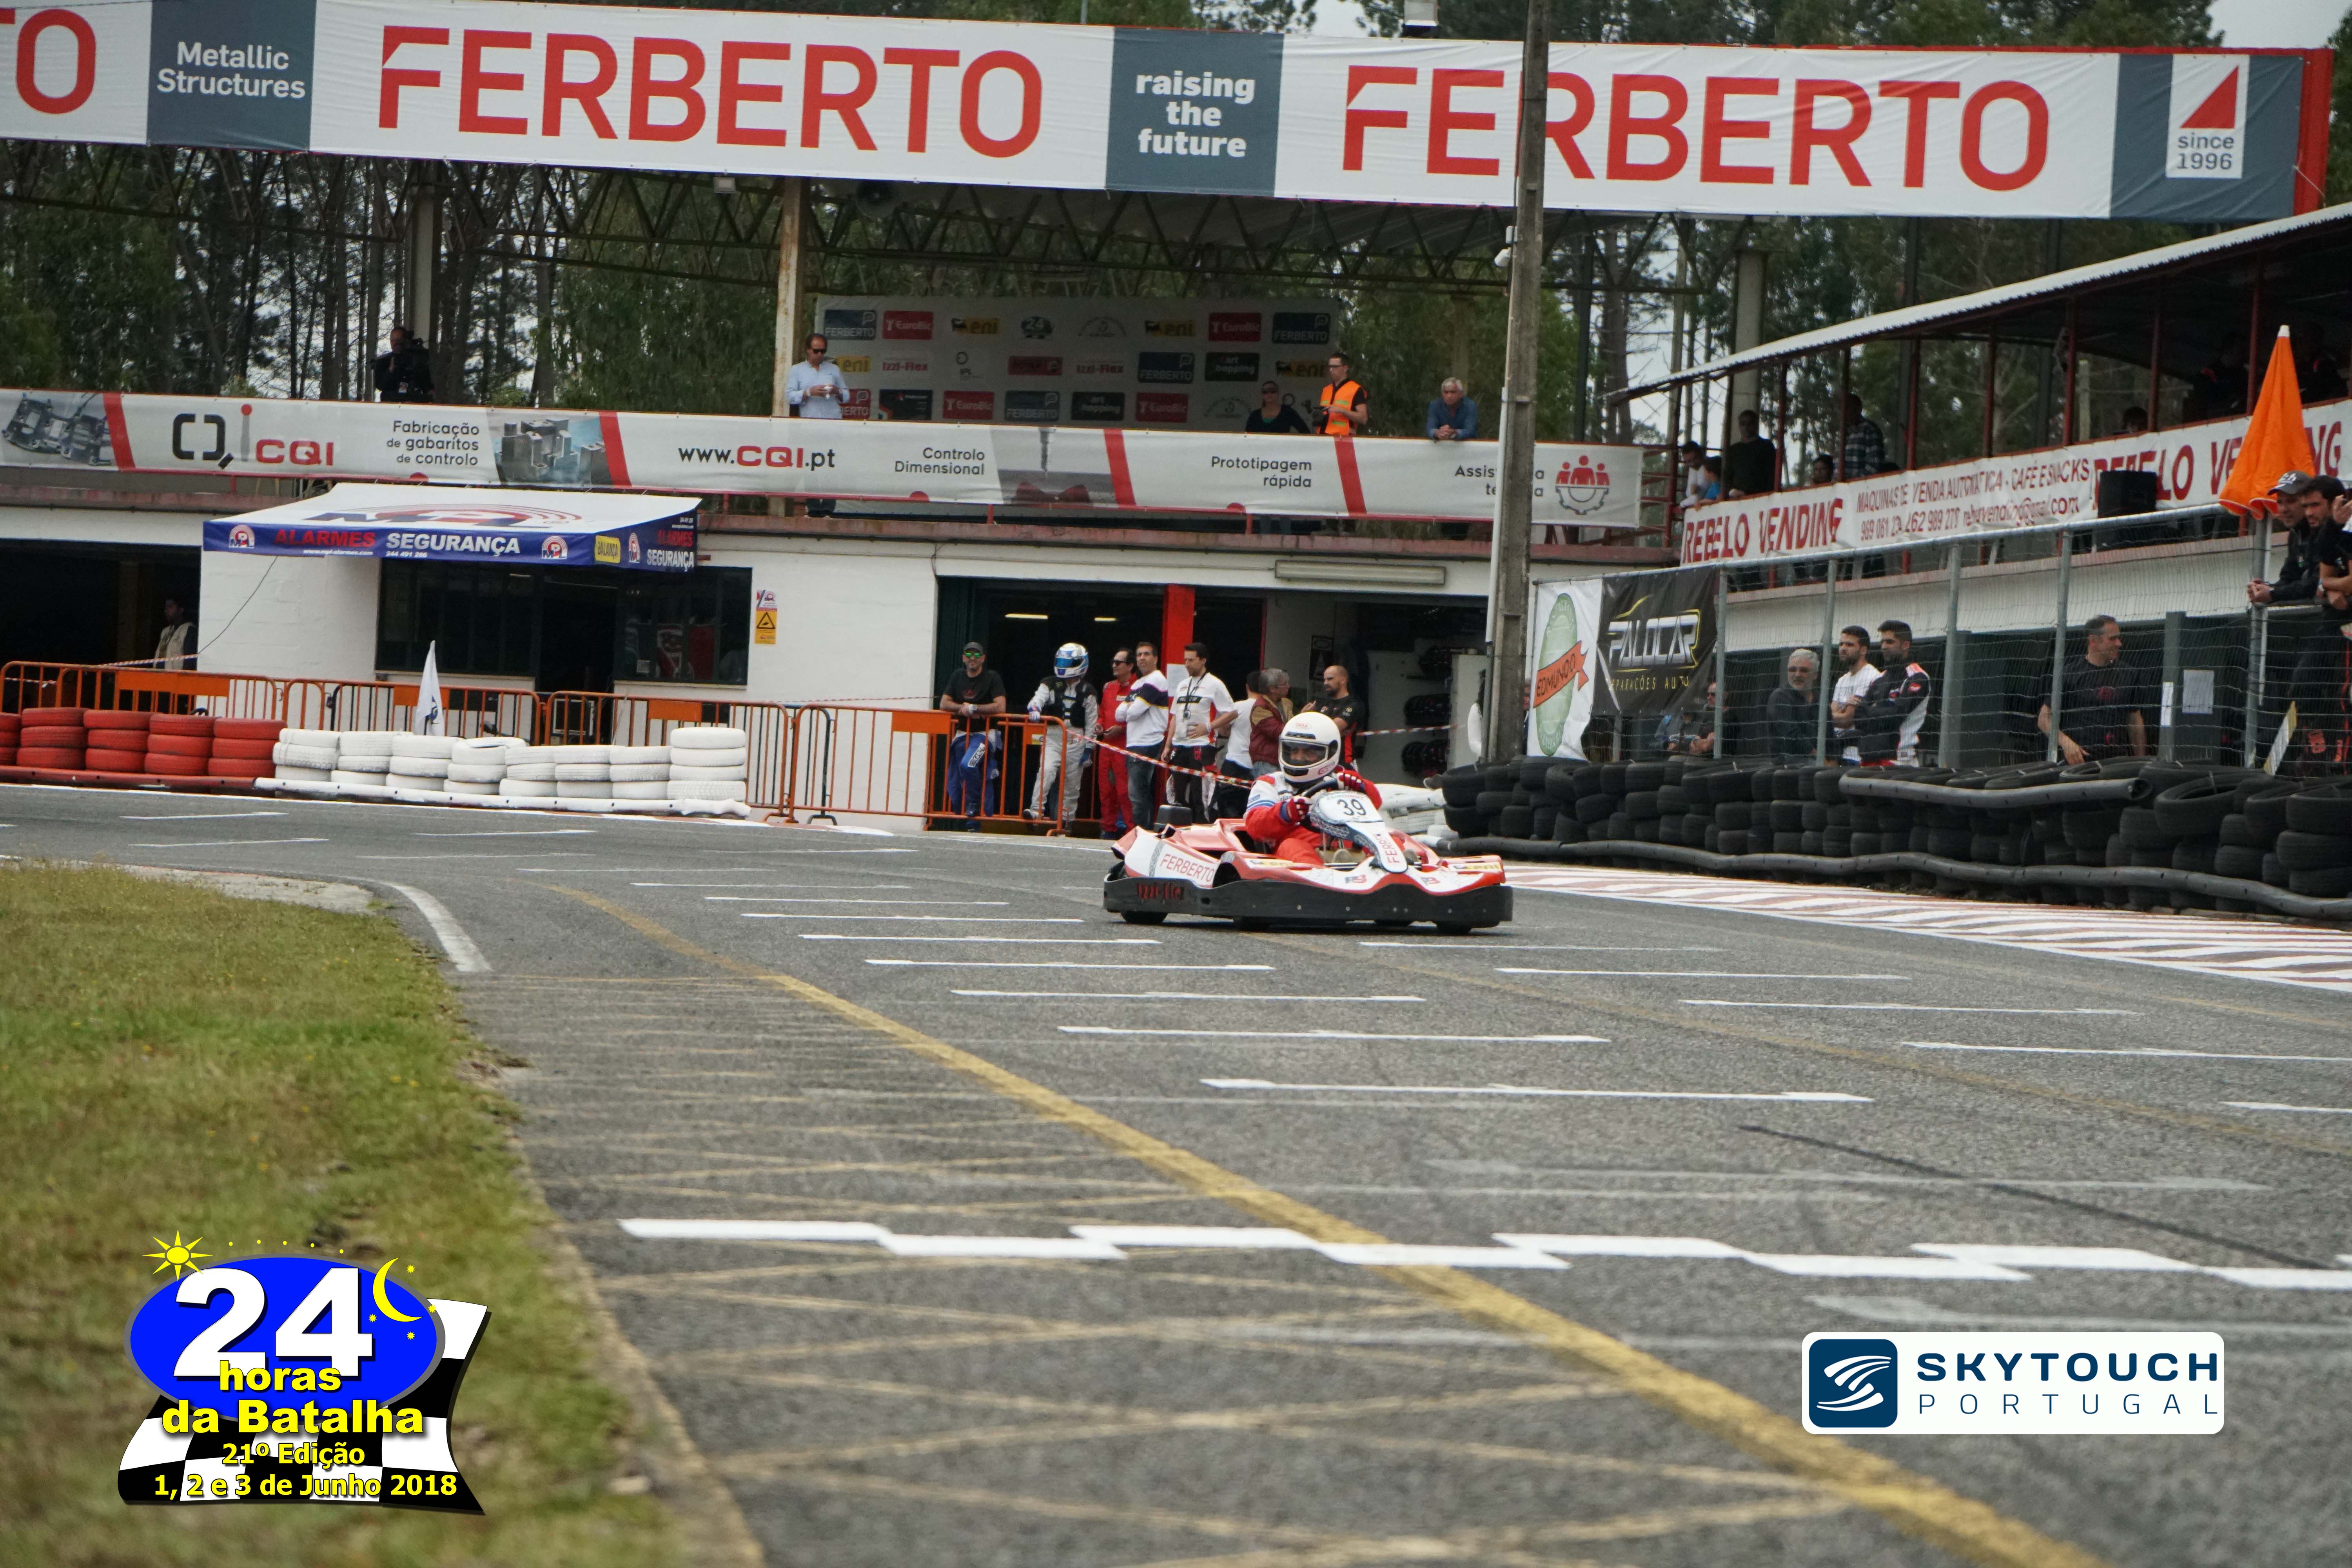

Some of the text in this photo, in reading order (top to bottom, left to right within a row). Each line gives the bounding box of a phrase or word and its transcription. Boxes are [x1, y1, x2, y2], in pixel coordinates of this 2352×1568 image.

[0, 8, 96, 114] O
[177, 41, 289, 70] Metallic
[157, 69, 306, 99] Structures
[378, 25, 1042, 158] FERBERTO
[1136, 71, 1255, 105] raising
[1166, 101, 1222, 127] the
[1342, 65, 2049, 192] FERBERTO
[1138, 128, 1247, 158] future
[2177, 132, 2235, 150] since
[2176, 152, 2232, 171] 1996
[393, 420, 479, 438] Fabricação
[256, 439, 334, 466] CQI
[387, 437, 479, 452] de gabaritos
[923, 447, 985, 461] Controlo
[397, 452, 478, 466] de controlo
[678, 445, 835, 472] www.CQI.pt
[895, 461, 985, 475] Dimensional
[1211, 456, 1312, 473] Prototipagem
[1263, 475, 1312, 490] rápida
[1913, 480, 1944, 503] VENDA
[274, 529, 375, 548] ALARMES
[657, 529, 693, 547] ALARMES
[1682, 497, 1843, 563] REBELO VENDING
[386, 532, 521, 557] SEGURANÇA
[647, 549, 695, 572] SEGURANÇA
[1337, 799, 1367, 816] 39
[1160, 853, 1214, 882] FERBERTO
